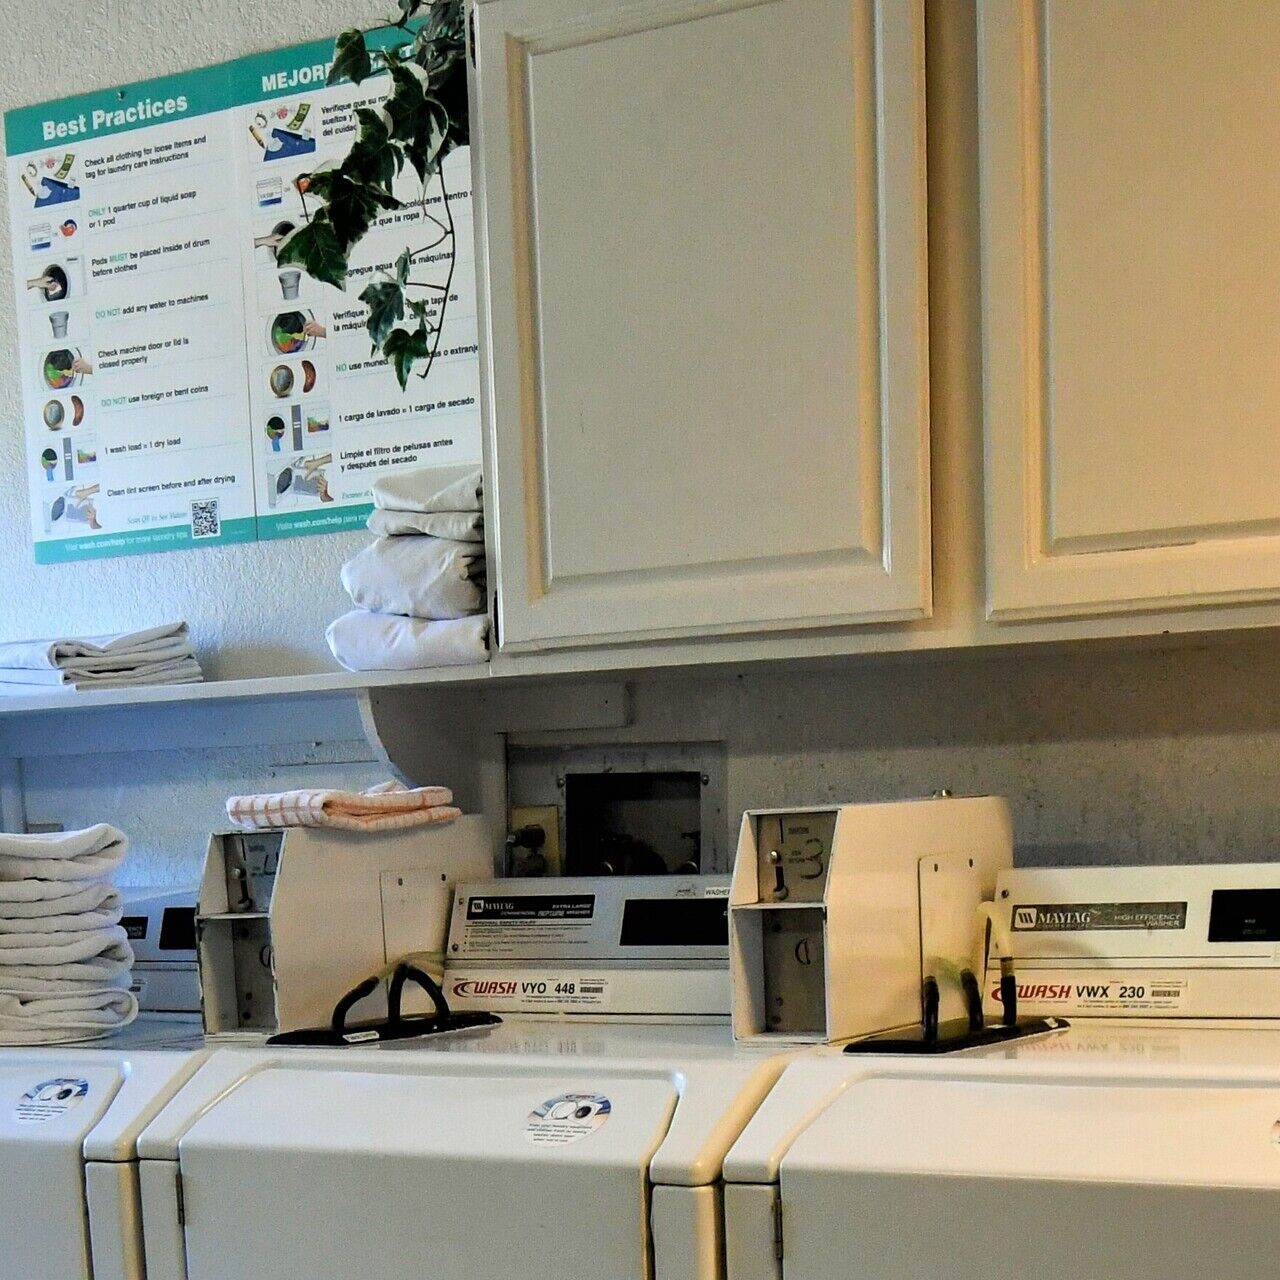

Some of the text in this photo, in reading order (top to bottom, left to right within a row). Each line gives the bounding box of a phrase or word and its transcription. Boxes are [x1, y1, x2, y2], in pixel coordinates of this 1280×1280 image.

[42, 96, 188, 141] Best Practices
[85, 157, 104, 167] Check
[116, 150, 142, 161] clothing
[154, 144, 172, 153] loose
[174, 140, 192, 148] items
[194, 135, 206, 144] and
[85, 171, 95, 179] tag
[108, 163, 132, 174] laundry
[150, 151, 189, 165] instructions
[113, 202, 136, 213] quarter
[138, 200, 150, 208] cup
[152, 197, 158, 205] of
[161, 193, 178, 204] liquid
[181, 191, 196, 199] soap
[103, 218, 115, 227] pod
[92, 257, 107, 266] Pods
[140, 248, 160, 259] placed
[163, 244, 182, 252] inside
[193, 239, 209, 247] drum
[92, 263, 137, 277] before clothes
[123, 306, 134, 314] add
[136, 304, 147, 312] any
[149, 301, 167, 309] water
[177, 294, 208, 304] machines
[98, 349, 117, 358] Check
[120, 345, 146, 354] machine
[148, 342, 163, 350] door
[99, 355, 148, 369] closed properly
[344, 412, 364, 422] carga
[366, 410, 374, 418] de
[377, 407, 400, 417] lavado
[415, 404, 435, 412] carga
[448, 397, 475, 407] secado
[340, 450, 364, 459] Limpie
[374, 447, 390, 455] filtro
[392, 445, 400, 453] de
[403, 441, 431, 453] pelusas
[433, 439, 453, 447] antes
[340, 464, 345, 472] y
[347, 460, 377, 470] después
[391, 455, 417, 464] secado
[107, 475, 235, 496] Clean lint screen before and after drying
[484, 902, 514, 910] MAYTAG
[1038, 912, 1091, 924] MAYTAG
[1136, 913, 1181, 921] EFFICIENCY
[473, 981, 517, 994] WASH
[522, 982, 575, 994] VYO 448
[1018, 985, 1071, 999] WASH
[1076, 986, 1145, 998] VWX 230
